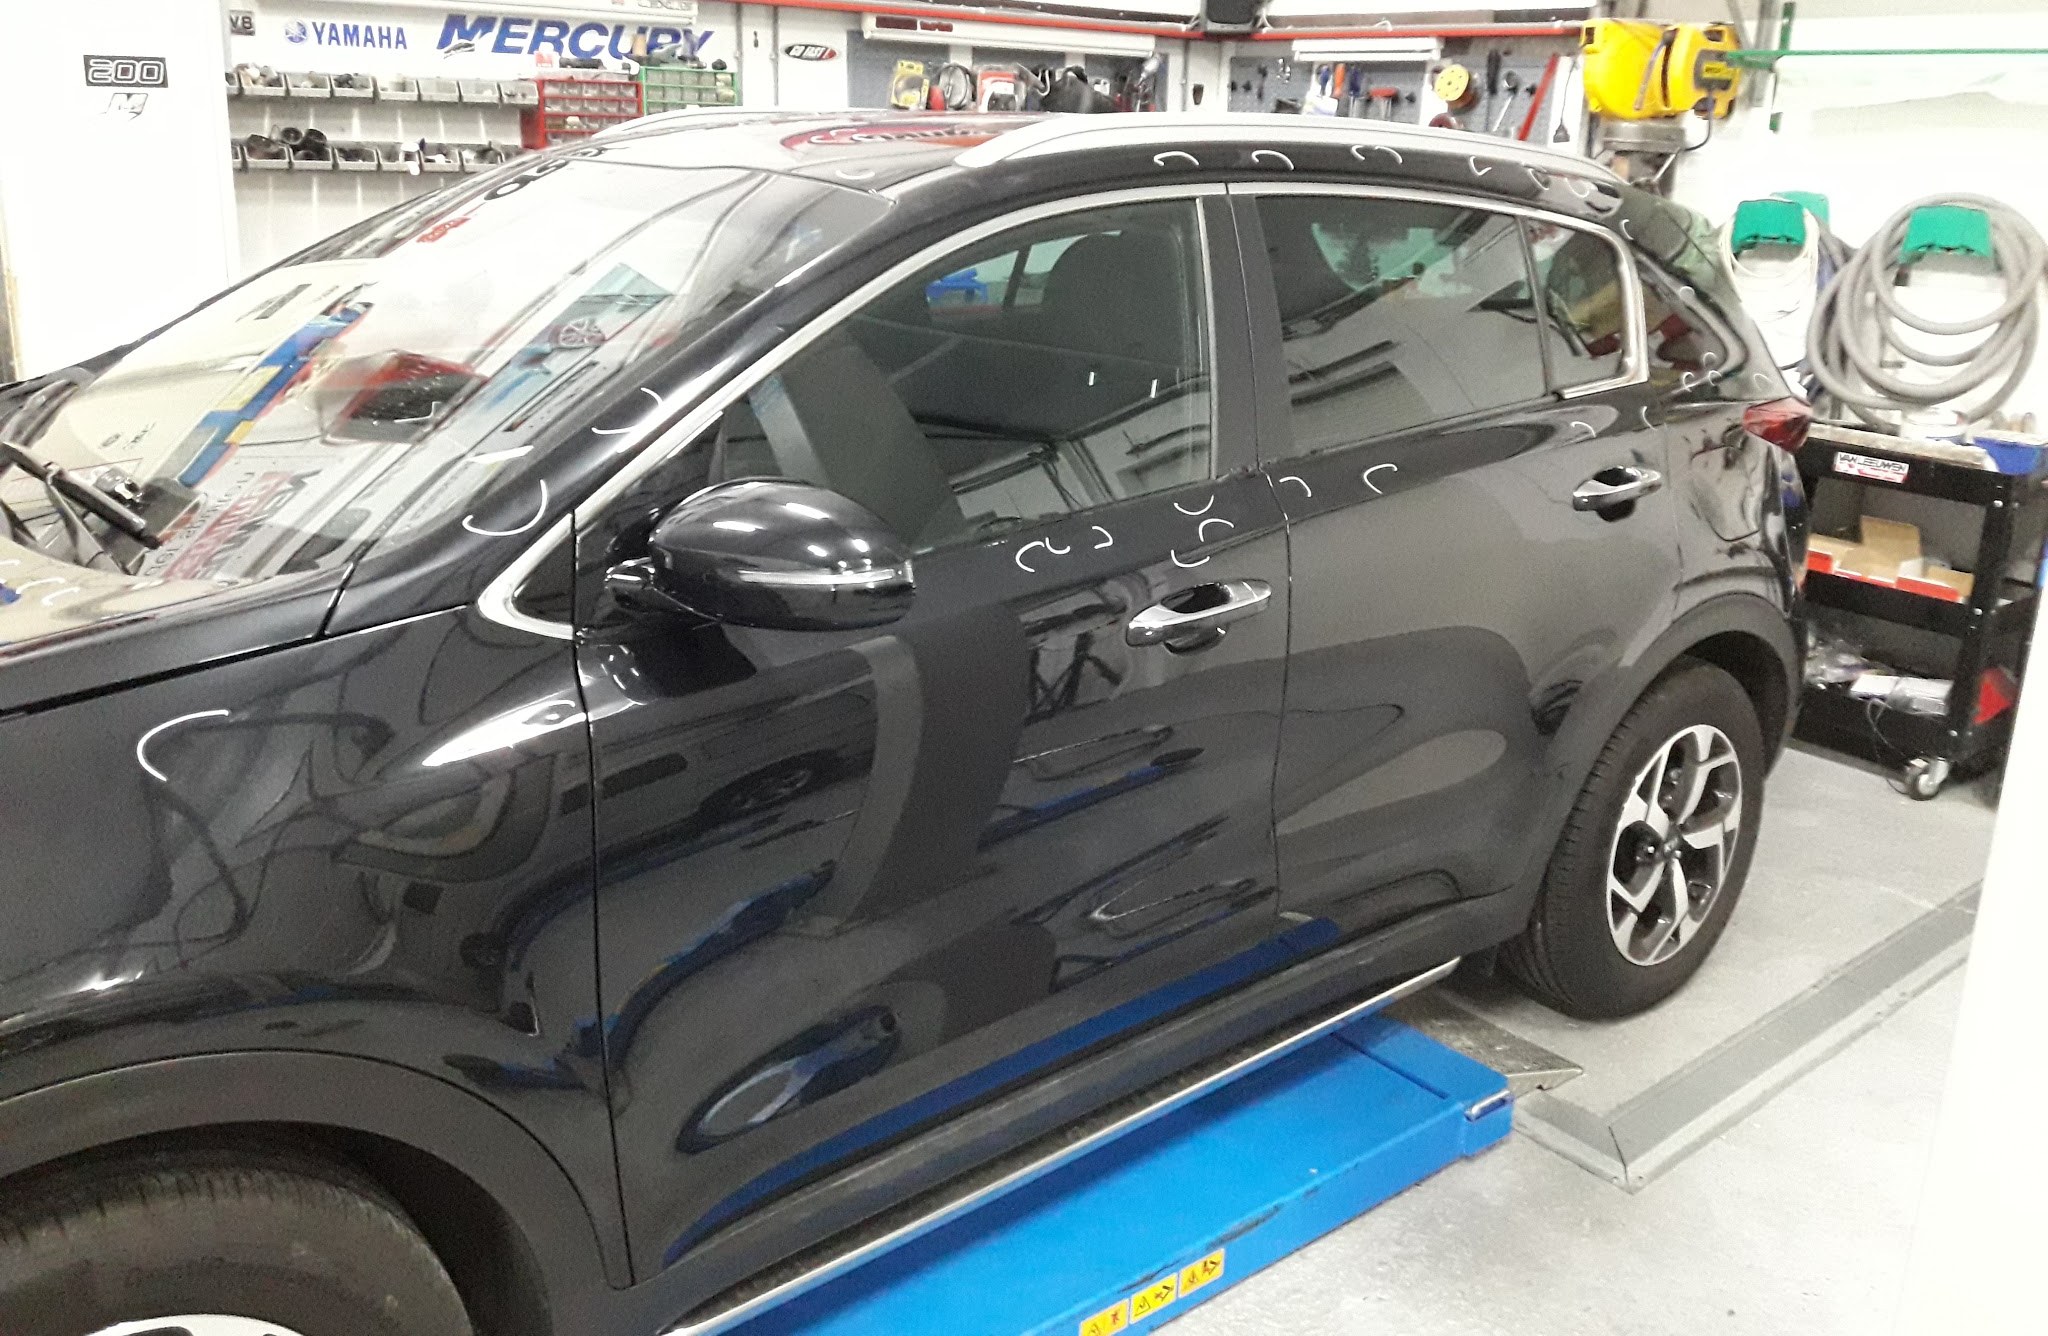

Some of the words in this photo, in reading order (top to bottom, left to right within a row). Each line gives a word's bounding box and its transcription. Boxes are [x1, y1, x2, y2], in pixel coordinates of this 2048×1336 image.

[229, 15, 253, 29] V8
[312, 22, 407, 49] YAMAHA
[87, 58, 165, 85] 200
[1839, 453, 1858, 463] VAN
